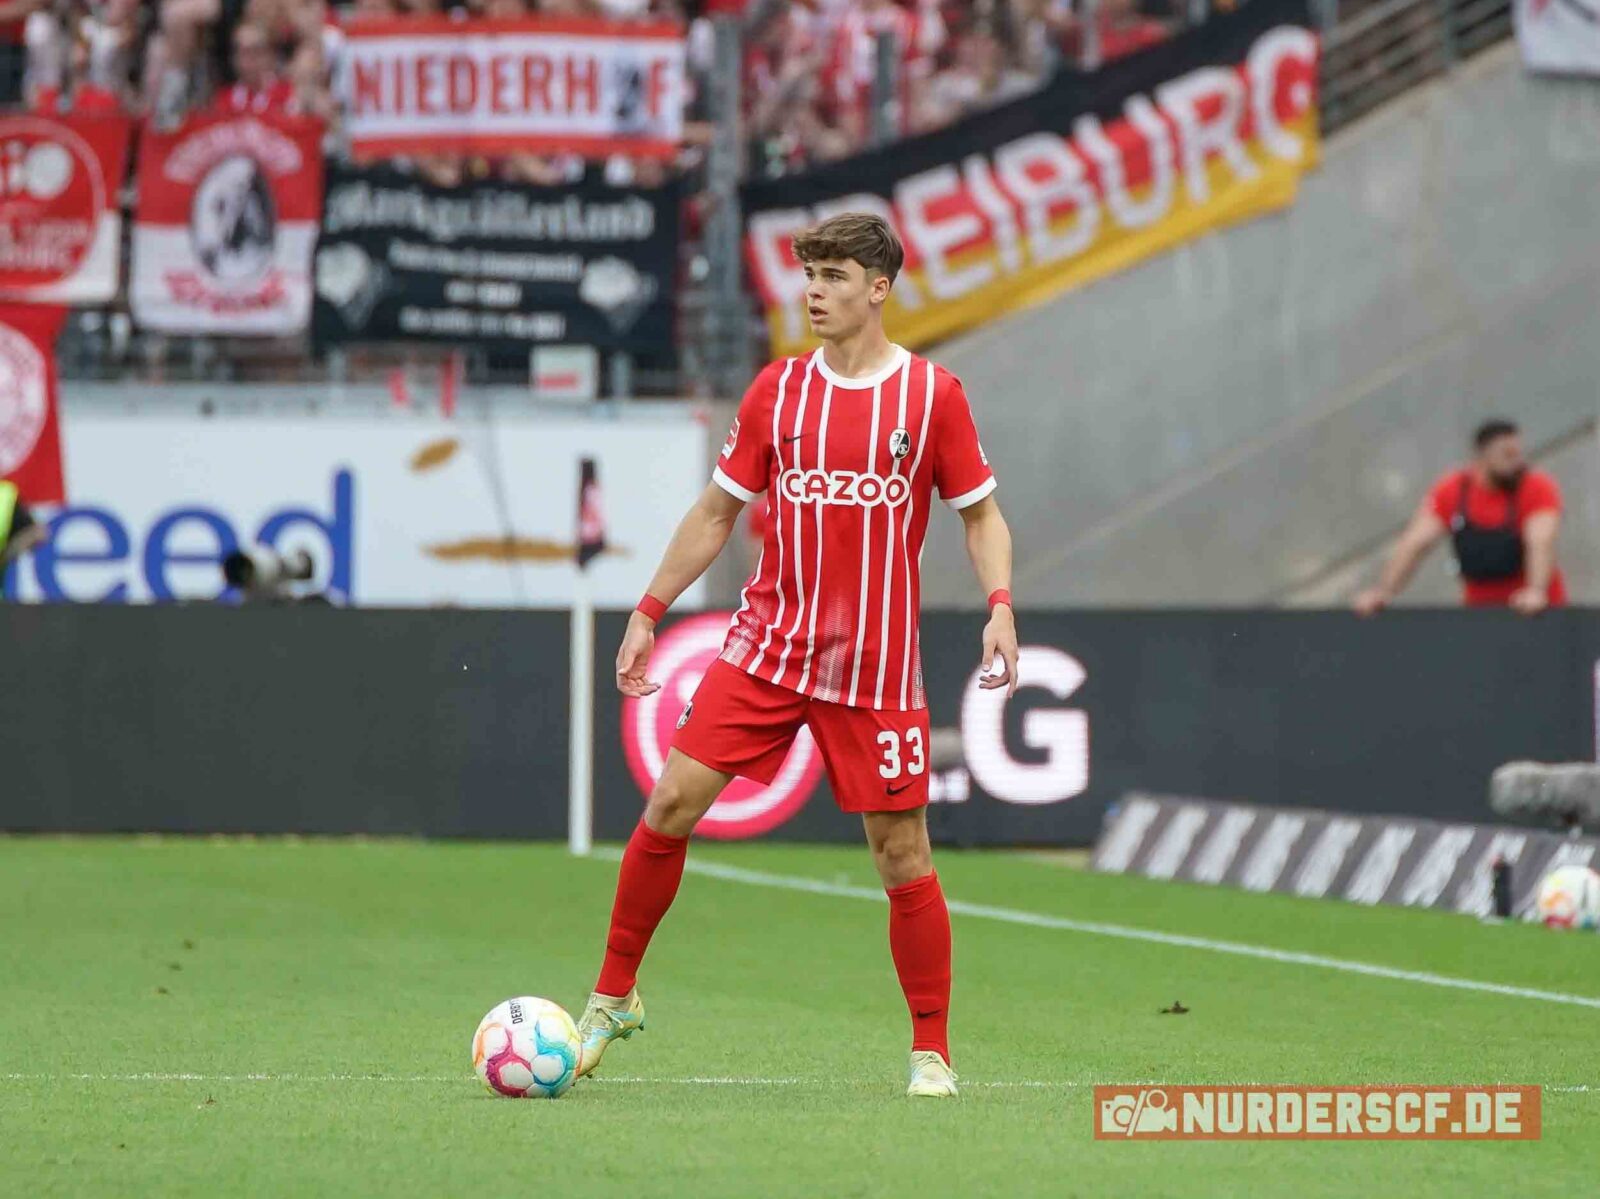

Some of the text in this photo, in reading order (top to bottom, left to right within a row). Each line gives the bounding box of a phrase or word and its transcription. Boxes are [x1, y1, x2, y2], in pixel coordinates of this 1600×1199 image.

[353, 54, 670, 119] NIEDERHF
[784, 472, 907, 505] CAZOO
[2, 467, 355, 604] eed
[877, 726, 925, 779] 33
